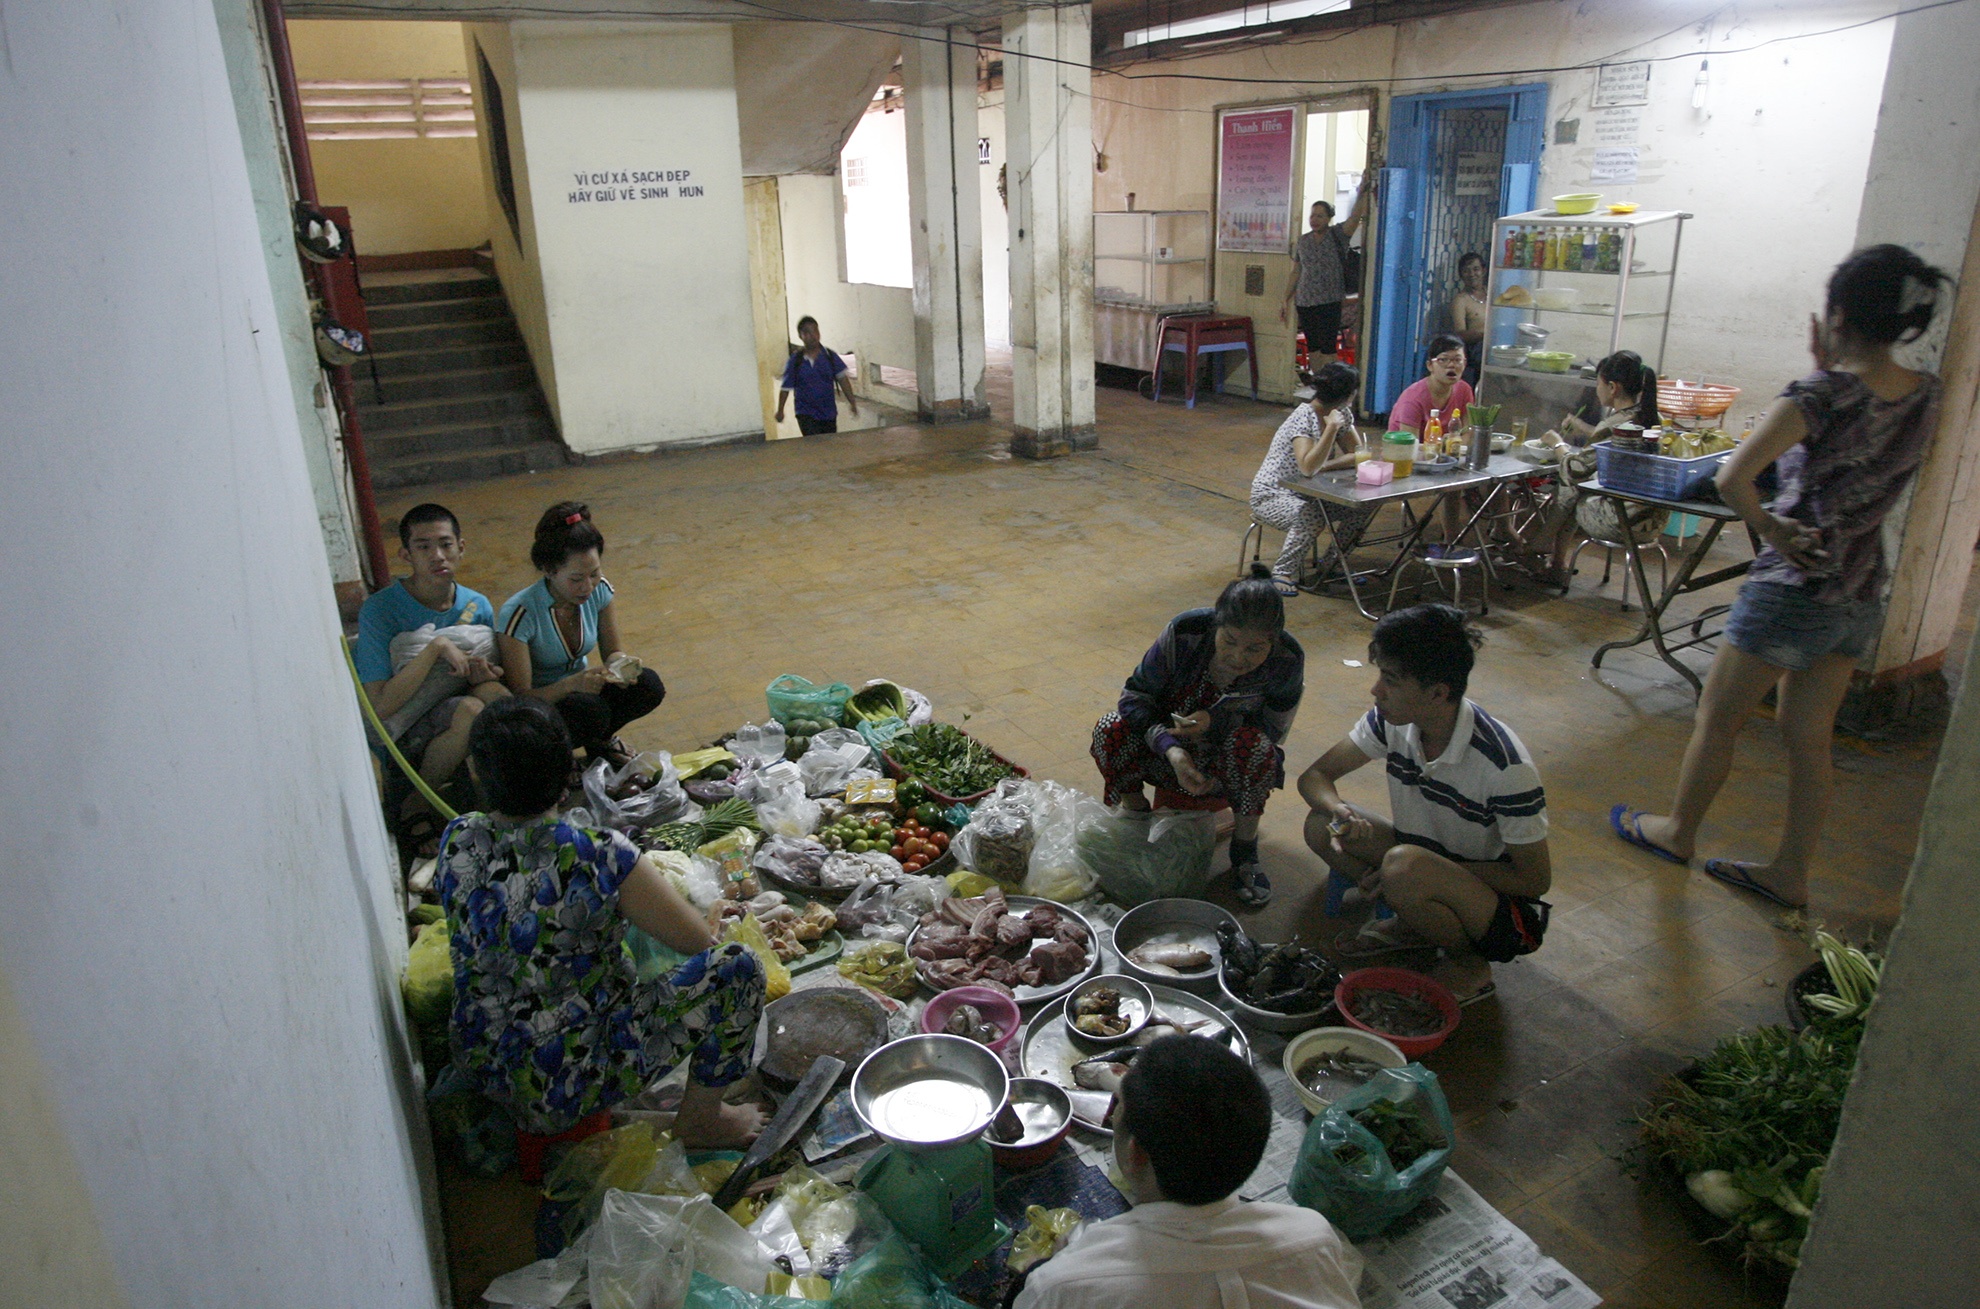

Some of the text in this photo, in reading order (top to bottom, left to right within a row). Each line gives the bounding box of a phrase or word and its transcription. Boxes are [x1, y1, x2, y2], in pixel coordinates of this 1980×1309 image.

[1232, 121, 1258, 133] Thanh
[591, 171, 609, 185] CƯ
[632, 171, 664, 186] SẠCH
[666, 170, 691, 185] ĐẸP
[640, 187, 669, 200] SINH
[679, 186, 704, 198] HUN
